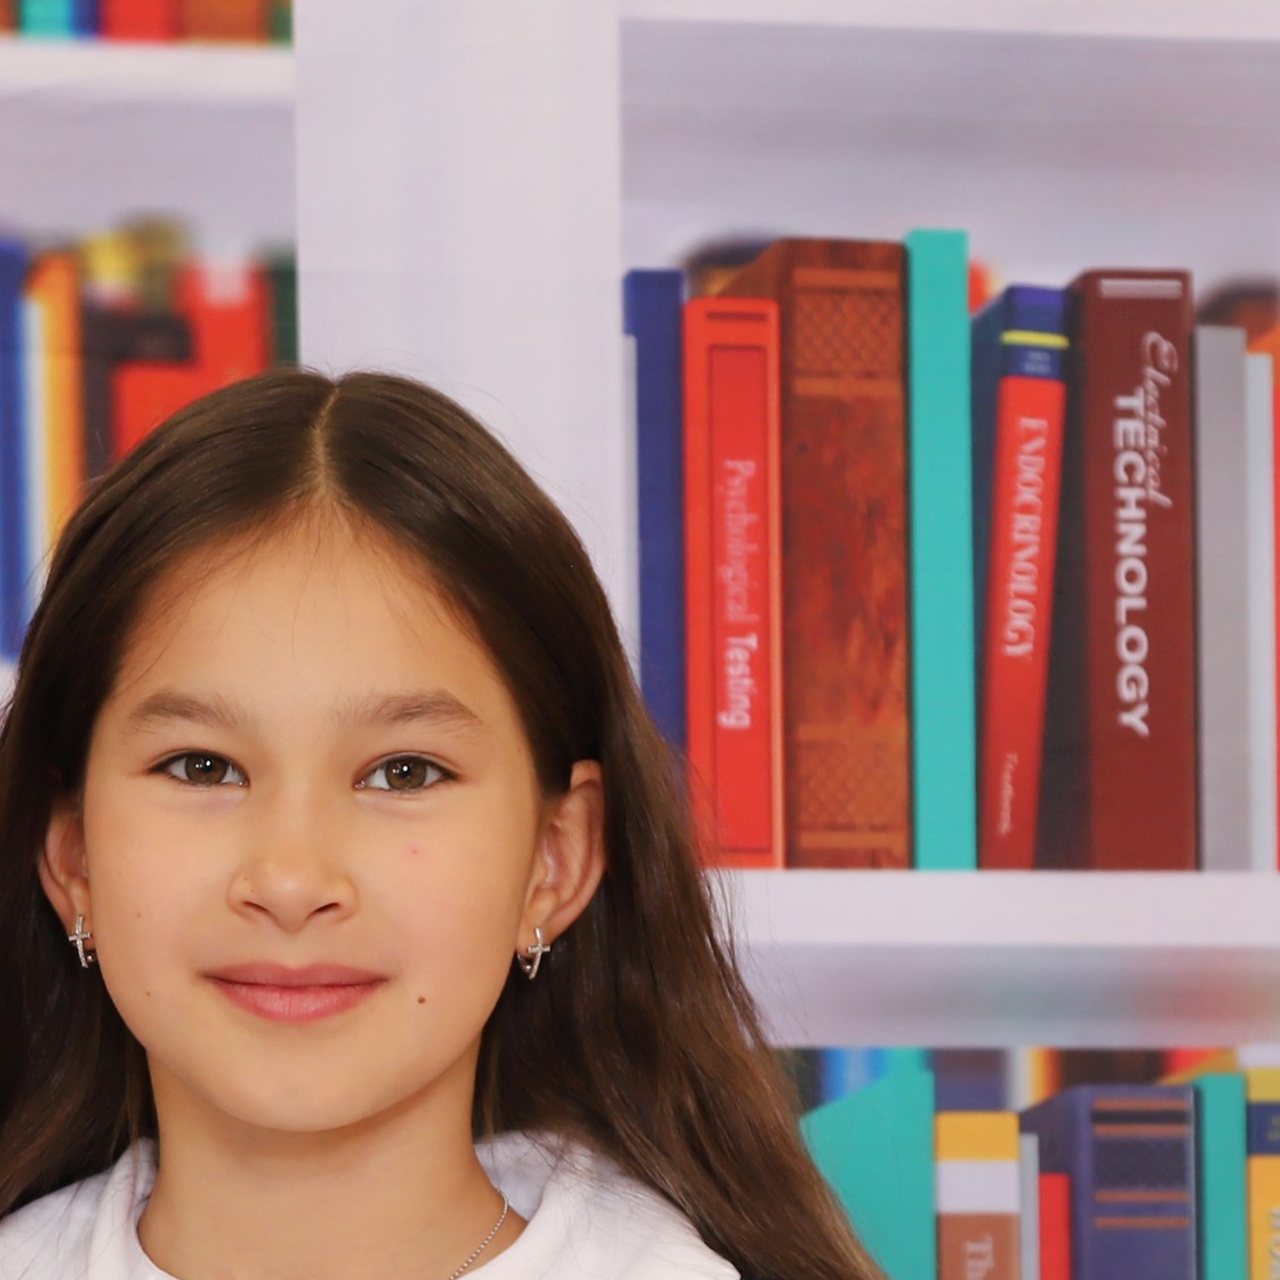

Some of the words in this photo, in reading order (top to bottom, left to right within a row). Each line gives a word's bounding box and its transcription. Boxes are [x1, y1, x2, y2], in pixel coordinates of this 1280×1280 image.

[1141, 330, 1179, 508] Electrical
[1003, 416, 1048, 657] ENDOCRINOLOGY
[1114, 387, 1150, 737] TECHNOLOGY
[717, 632, 758, 729] Testing
